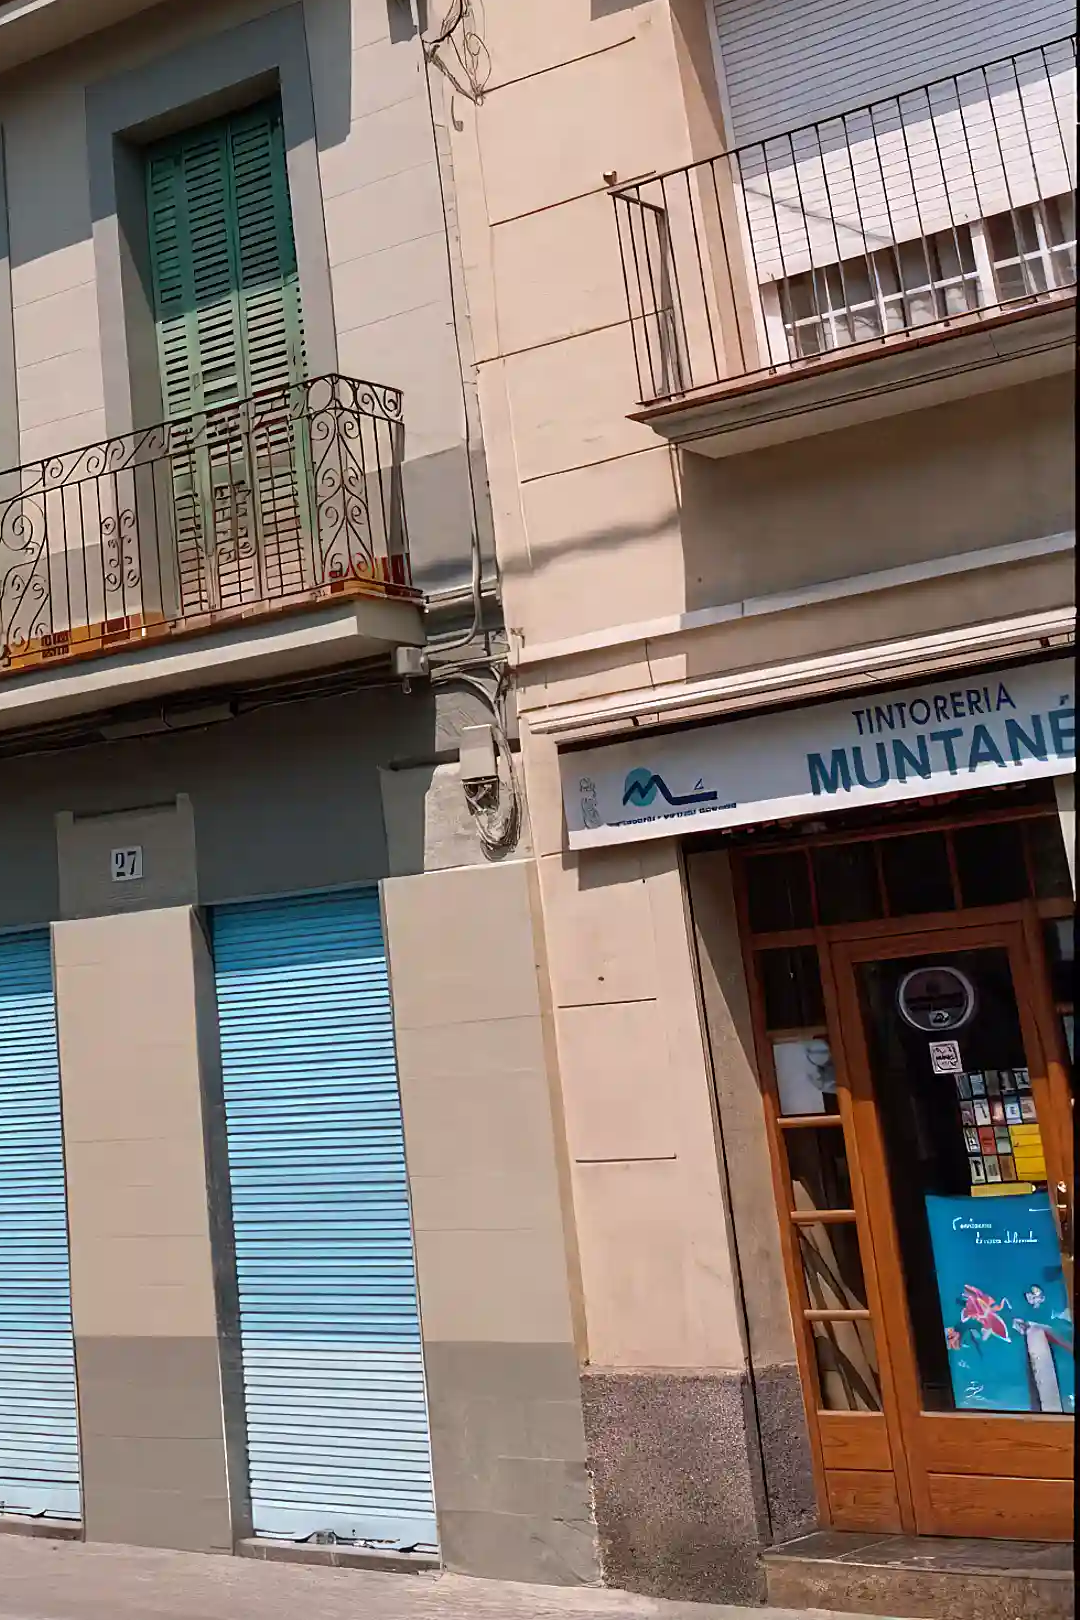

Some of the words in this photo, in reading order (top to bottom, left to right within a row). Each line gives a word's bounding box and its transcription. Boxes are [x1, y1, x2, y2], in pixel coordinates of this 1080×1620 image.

[851, 681, 1017, 736] TINTORERIA
[806, 693, 1076, 796] MUNTANÉ
[115, 850, 137, 878] 27
